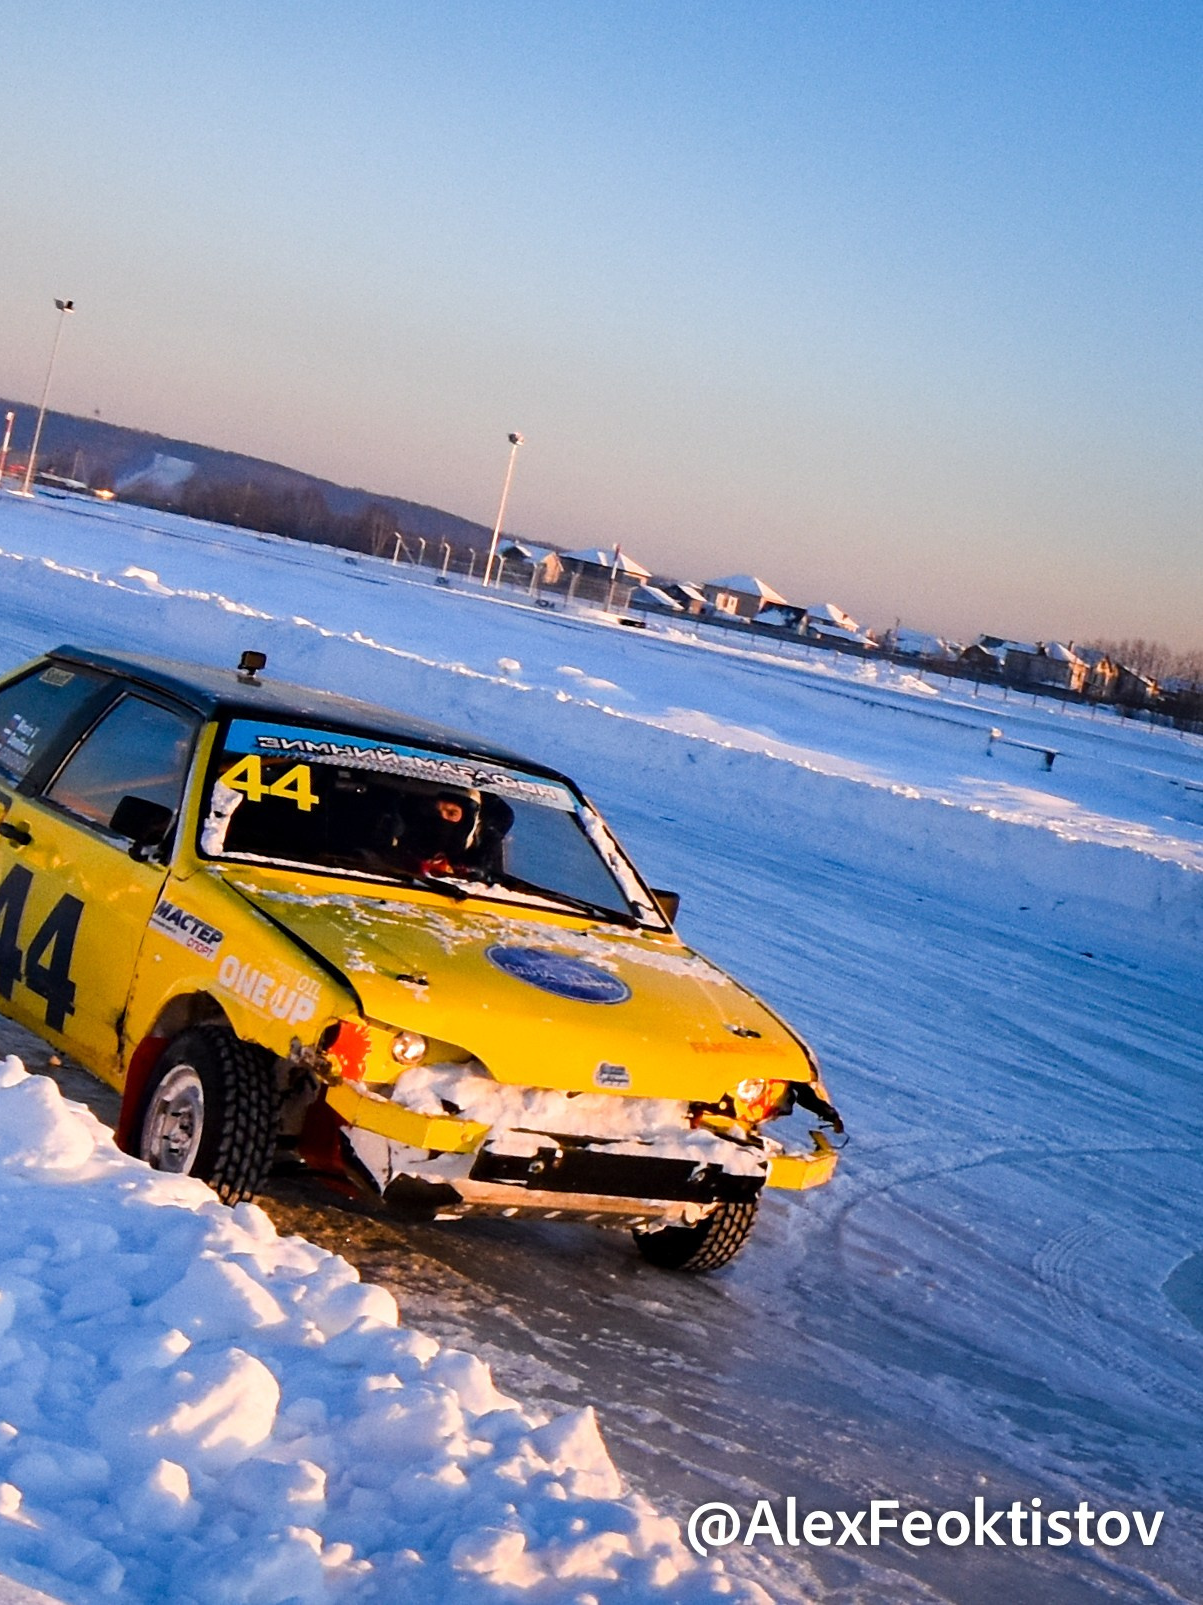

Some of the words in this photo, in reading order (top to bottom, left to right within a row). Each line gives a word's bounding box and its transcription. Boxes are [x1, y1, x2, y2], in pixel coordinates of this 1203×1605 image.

[257, 736, 400, 765] ЗИМНИЙ
[219, 754, 320, 812] 44
[154, 900, 224, 945] МАСТЕР
[186, 937, 214, 958] СПОРТ
[218, 954, 275, 1008] ONE
